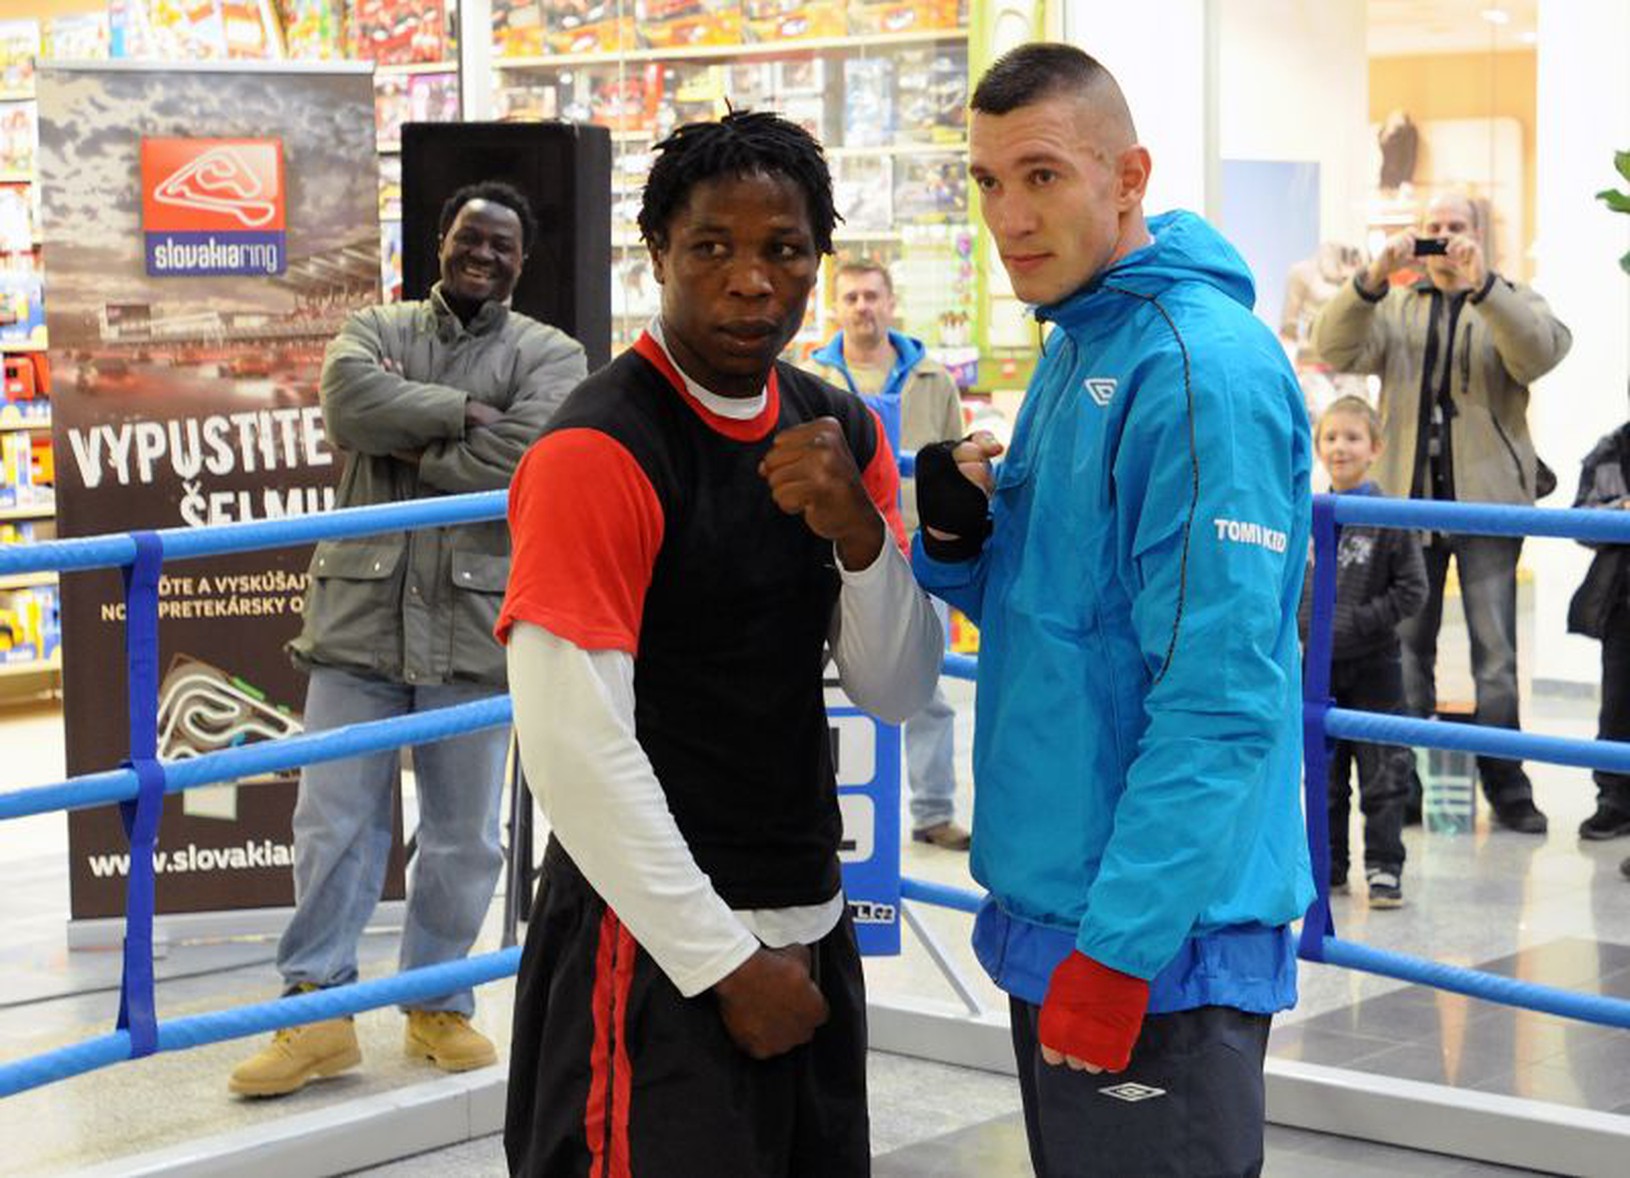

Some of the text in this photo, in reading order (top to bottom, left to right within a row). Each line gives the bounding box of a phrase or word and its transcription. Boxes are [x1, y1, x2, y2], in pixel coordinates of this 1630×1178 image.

[154, 236, 278, 273] slovakiaring
[67, 406, 334, 489] VYPUSTITE
[199, 577, 211, 594] A
[214, 571, 312, 594] VYSKÚŠAJ
[158, 595, 286, 618] PRETEKÁRSKY
